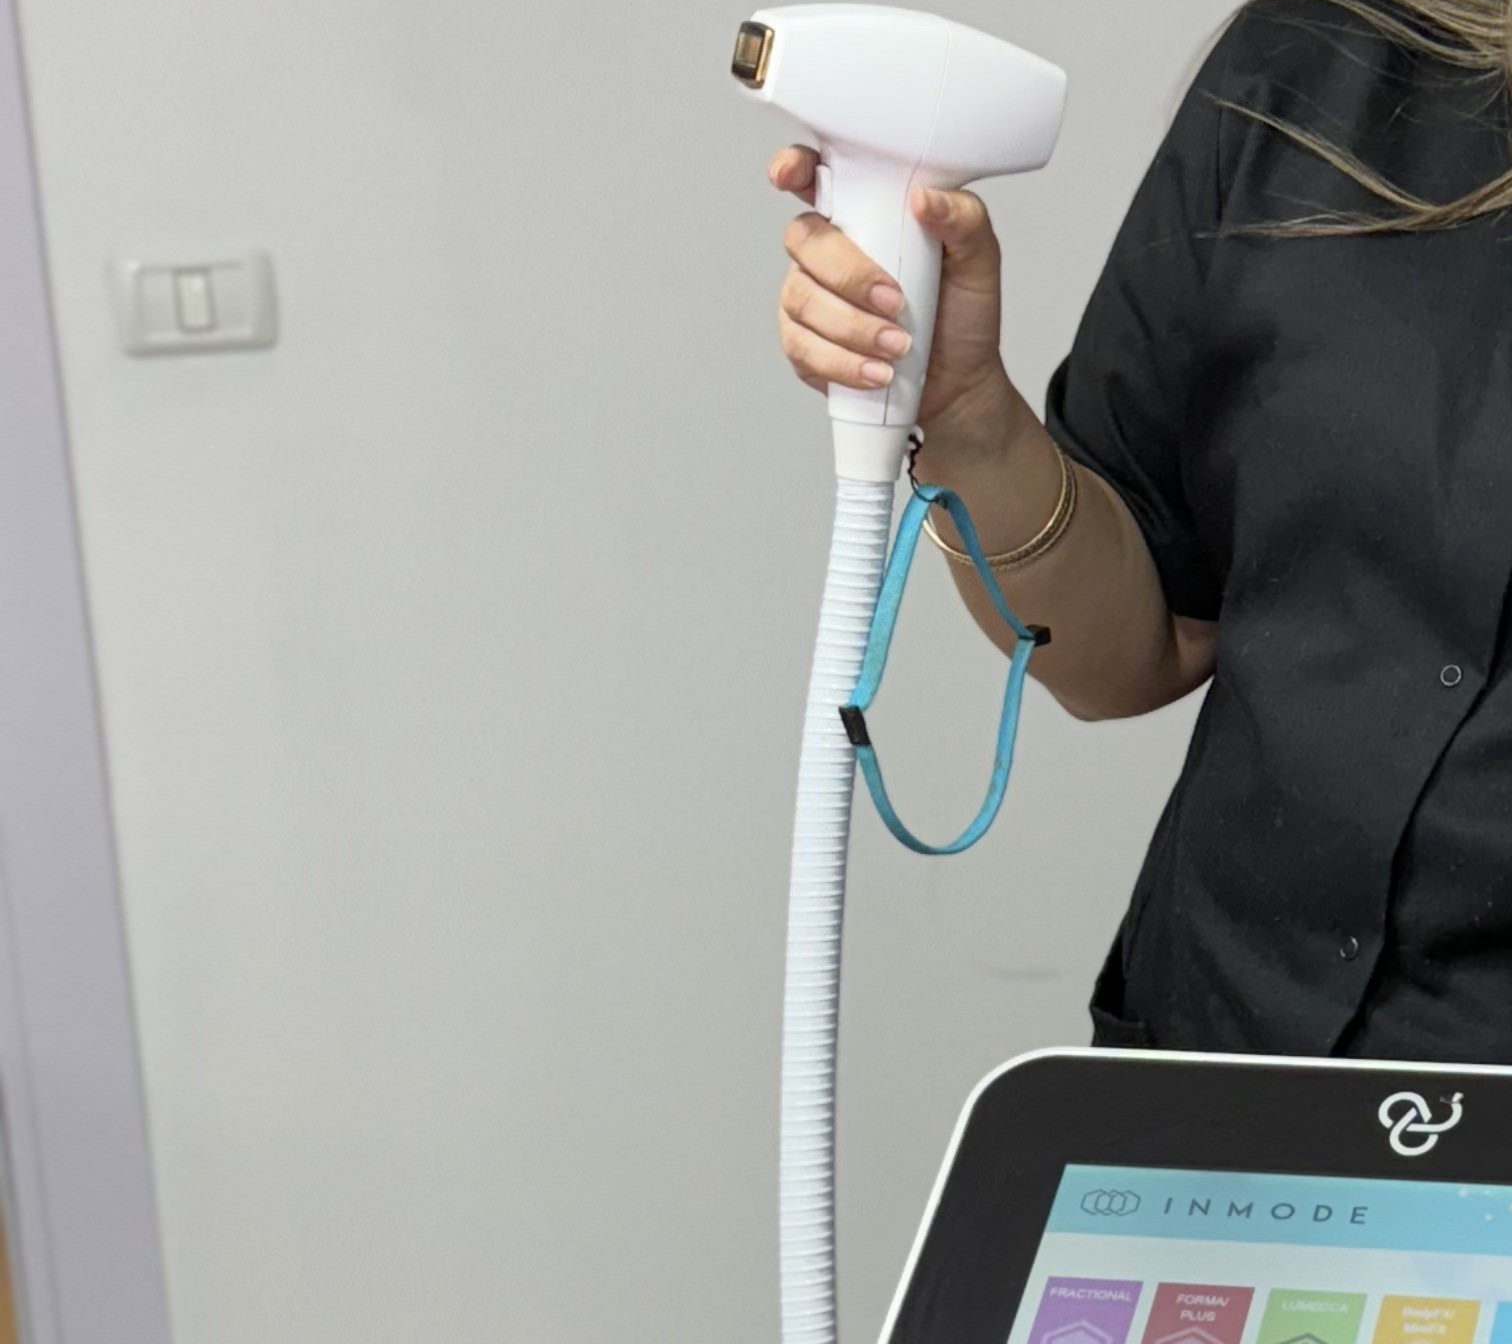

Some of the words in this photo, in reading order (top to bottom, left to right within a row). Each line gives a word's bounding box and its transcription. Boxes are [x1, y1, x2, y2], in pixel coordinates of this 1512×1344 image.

[1163, 1196, 1369, 1225] INMODE
[1050, 1285, 1133, 1304] FRACTIONAL
[1179, 1309, 1217, 1323] PLUS
